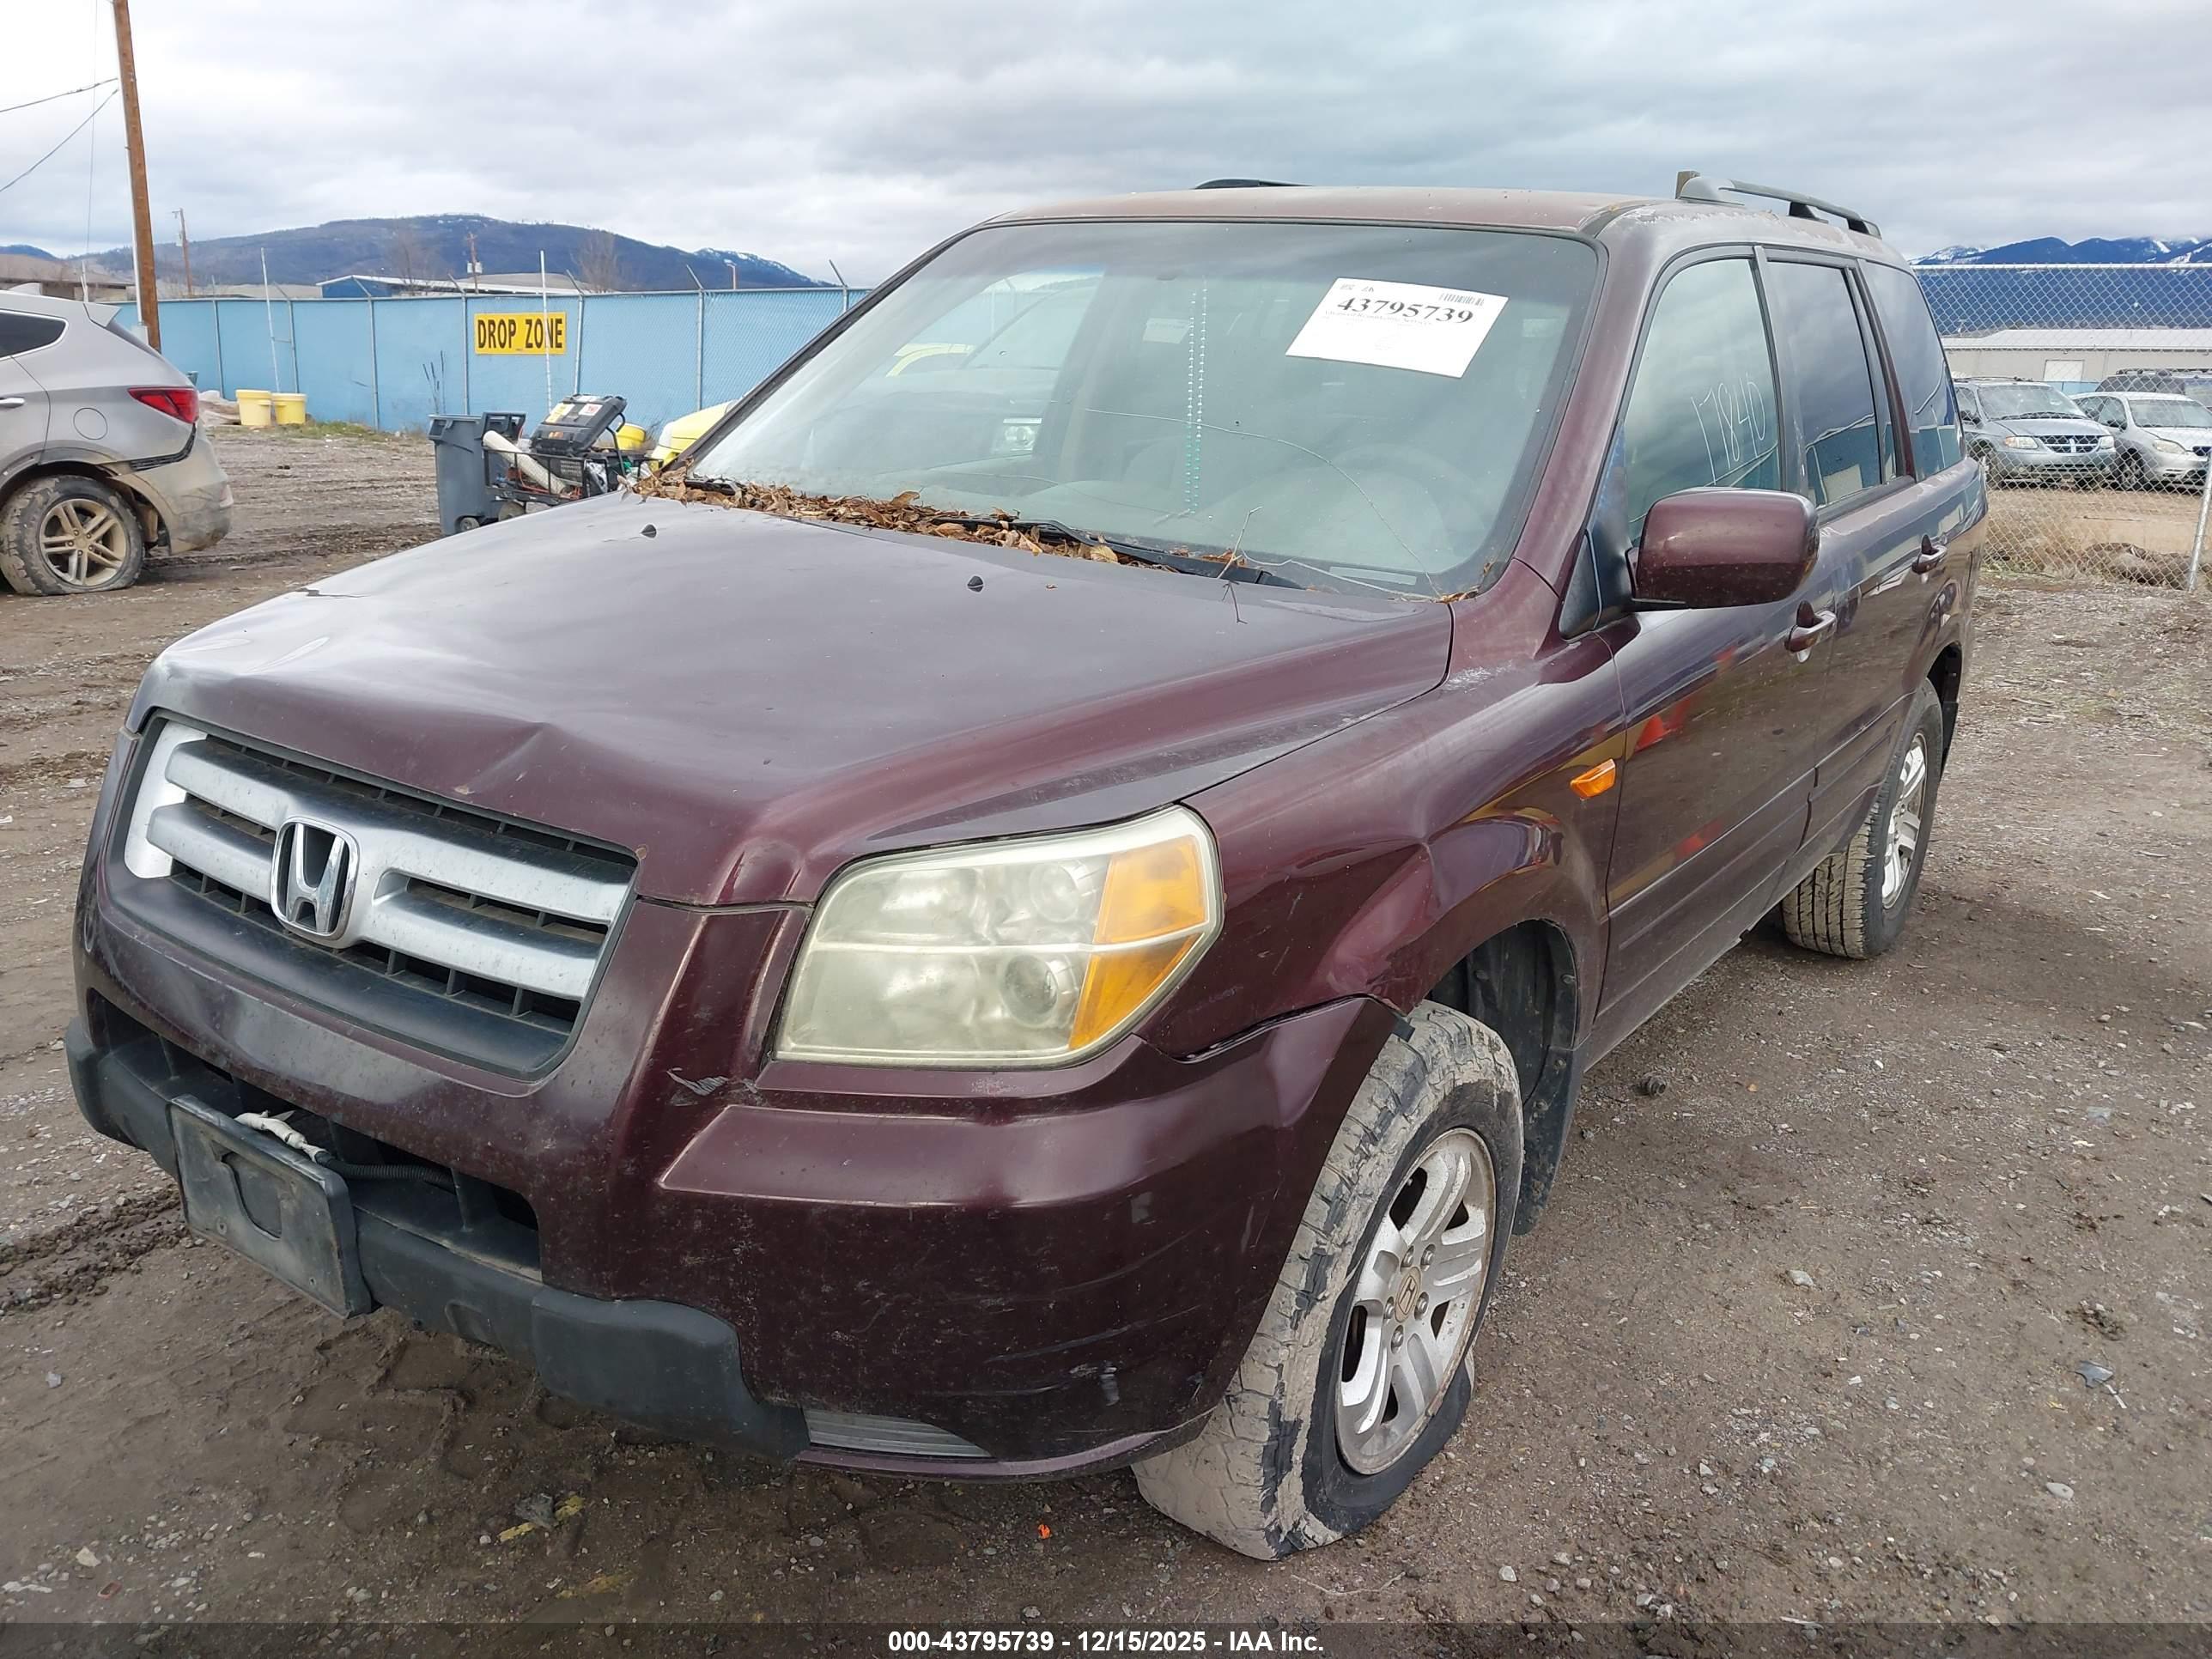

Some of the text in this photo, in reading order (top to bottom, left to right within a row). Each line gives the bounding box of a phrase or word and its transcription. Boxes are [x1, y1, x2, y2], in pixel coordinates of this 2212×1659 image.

[1337, 297, 1474, 324] 43795739
[477, 318, 562, 349] DROP ZONE
